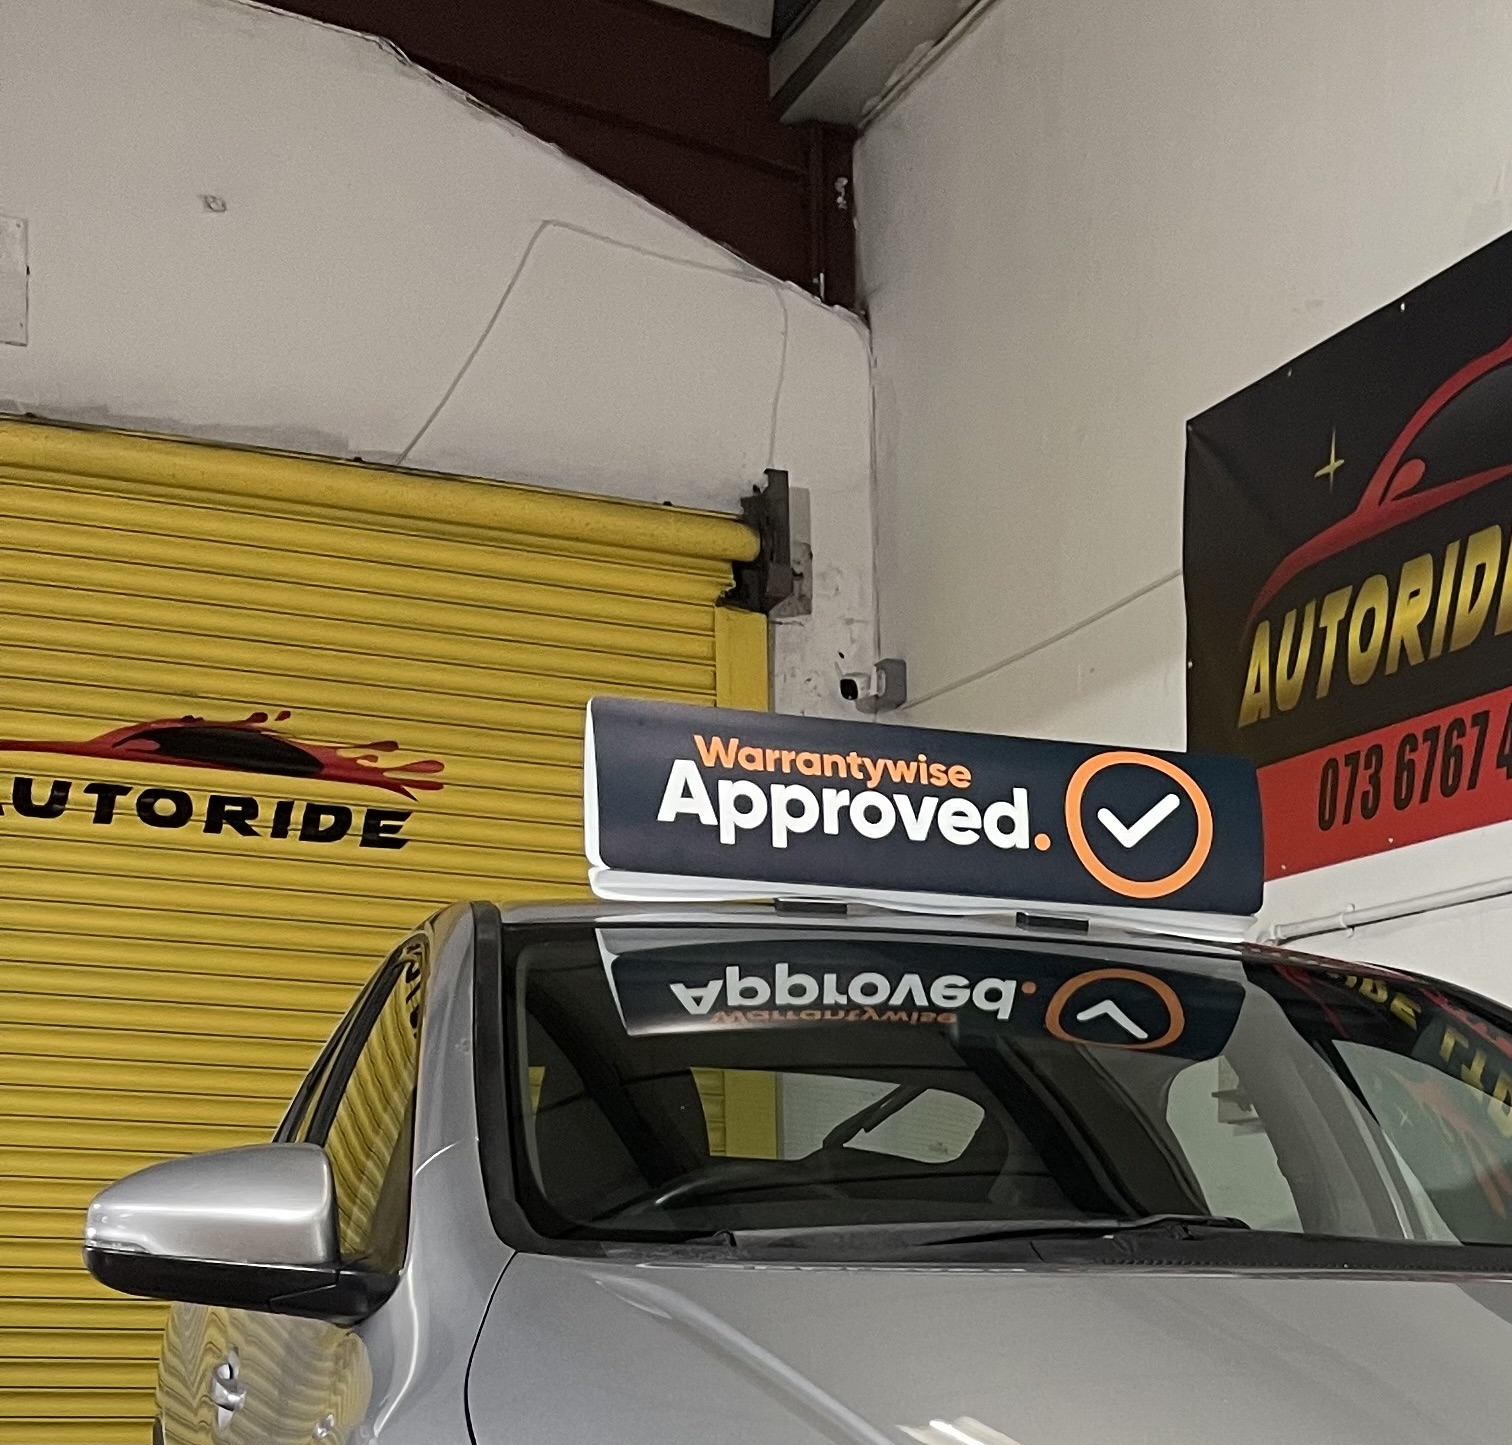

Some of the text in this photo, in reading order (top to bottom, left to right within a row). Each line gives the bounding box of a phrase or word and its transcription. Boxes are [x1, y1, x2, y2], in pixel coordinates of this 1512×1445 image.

[694, 734, 972, 789] Warrantywise
[1318, 744, 1384, 832] 073
[1393, 710, 1490, 811] 6767
[0, 776, 413, 849] UTORIDE
[656, 759, 1052, 851] Approved.
